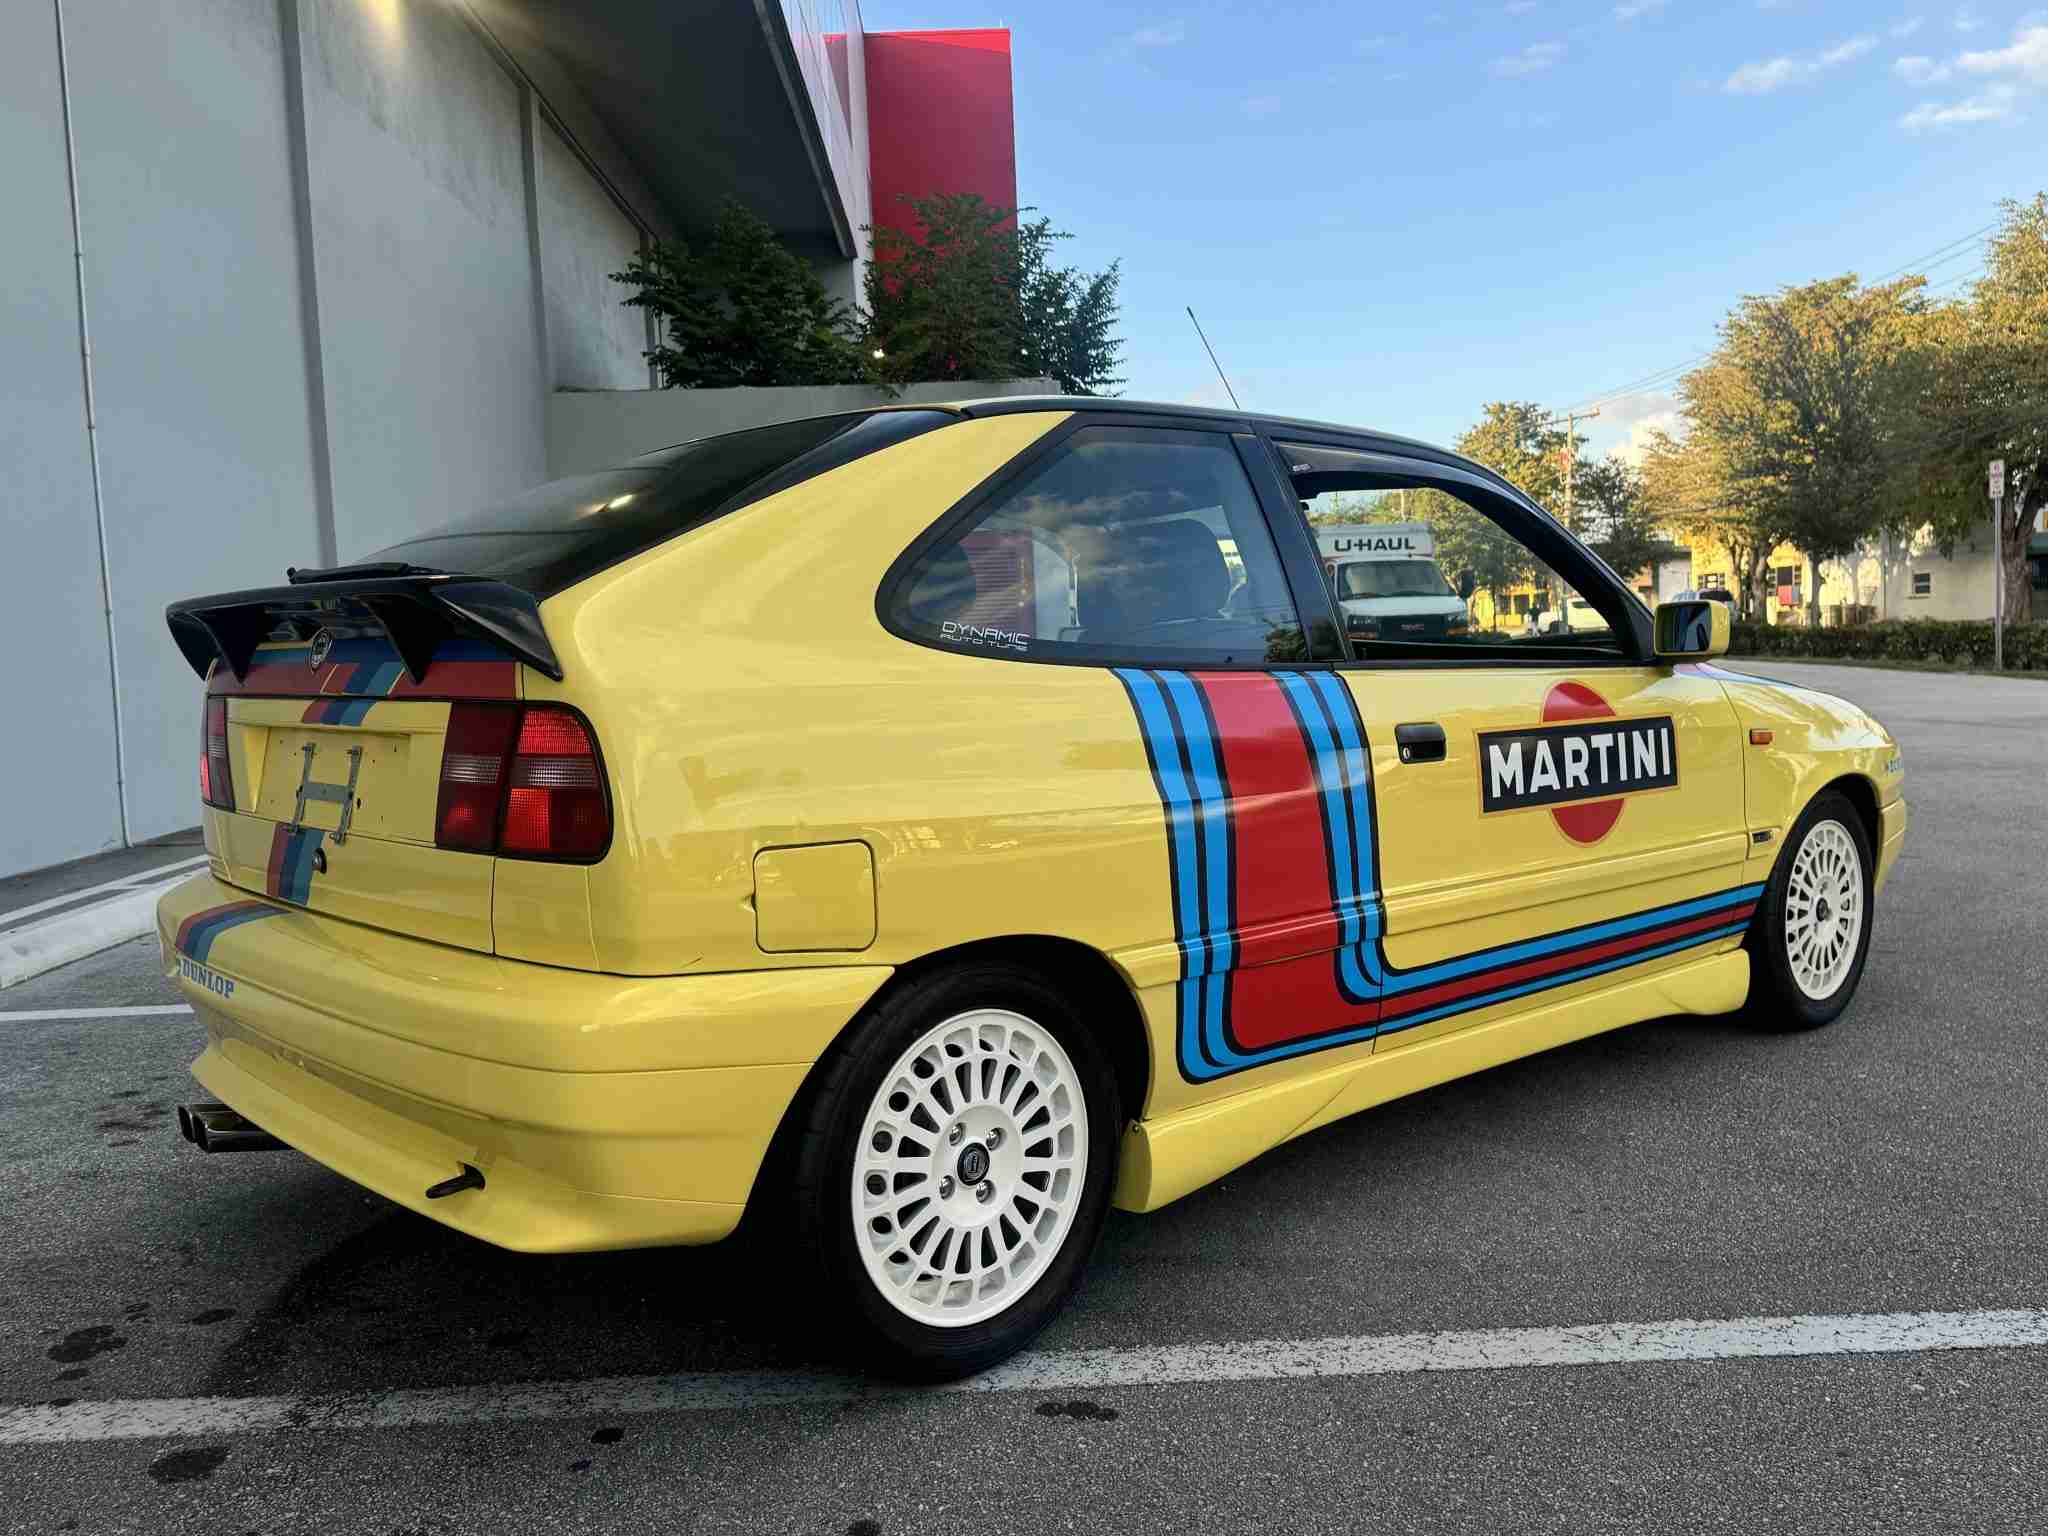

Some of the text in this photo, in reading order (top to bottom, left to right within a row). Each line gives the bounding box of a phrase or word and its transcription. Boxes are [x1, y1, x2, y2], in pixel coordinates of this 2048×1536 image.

[1334, 537, 1416, 552] U-HAUL
[940, 633, 983, 645] AUTO
[942, 621, 1031, 645] DYNAMIC
[1489, 728, 1671, 798] MARTINI
[182, 958, 234, 999] DUNLOP
